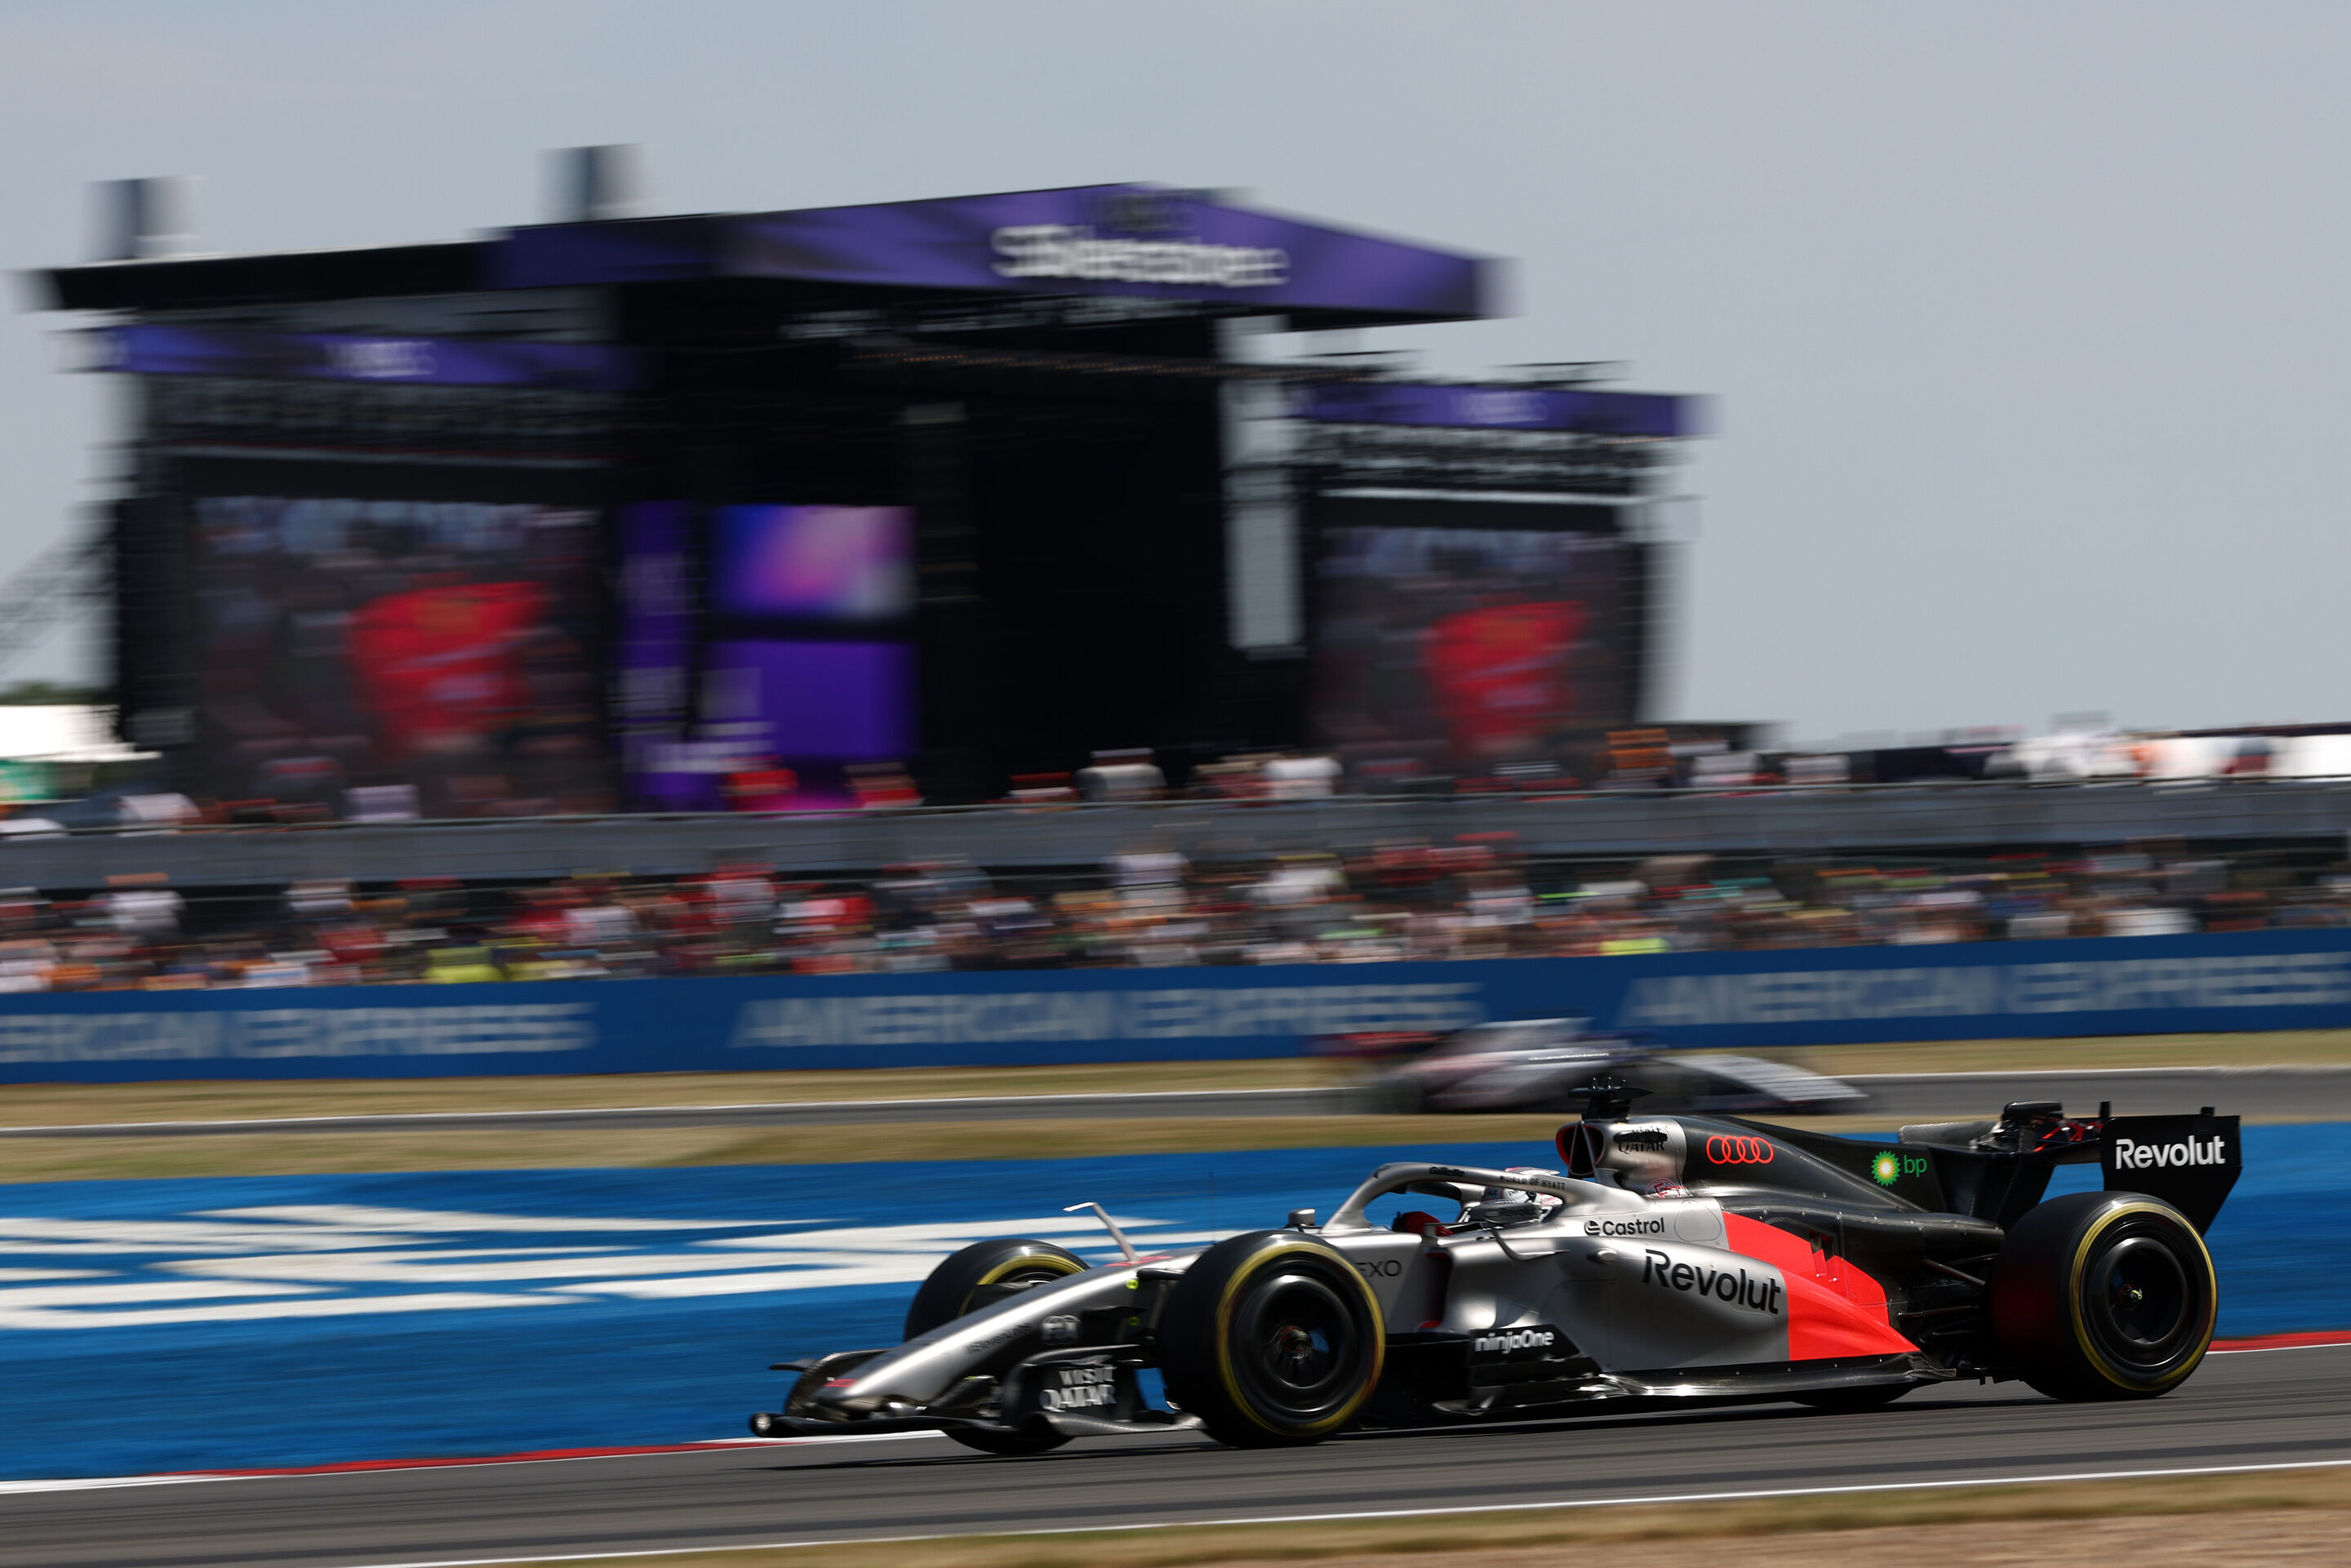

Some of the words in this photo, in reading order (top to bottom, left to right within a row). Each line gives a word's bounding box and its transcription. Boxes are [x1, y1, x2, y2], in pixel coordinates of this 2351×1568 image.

[1904, 1154, 1927, 1177] bp
[2116, 1135, 2225, 1170] Revolut
[1602, 1217, 1665, 1236] Castrol
[1642, 1248, 1781, 1315] Revolut
[1474, 1330, 1554, 1354] ninjaOne
[1039, 1384, 1118, 1413] QATAR
